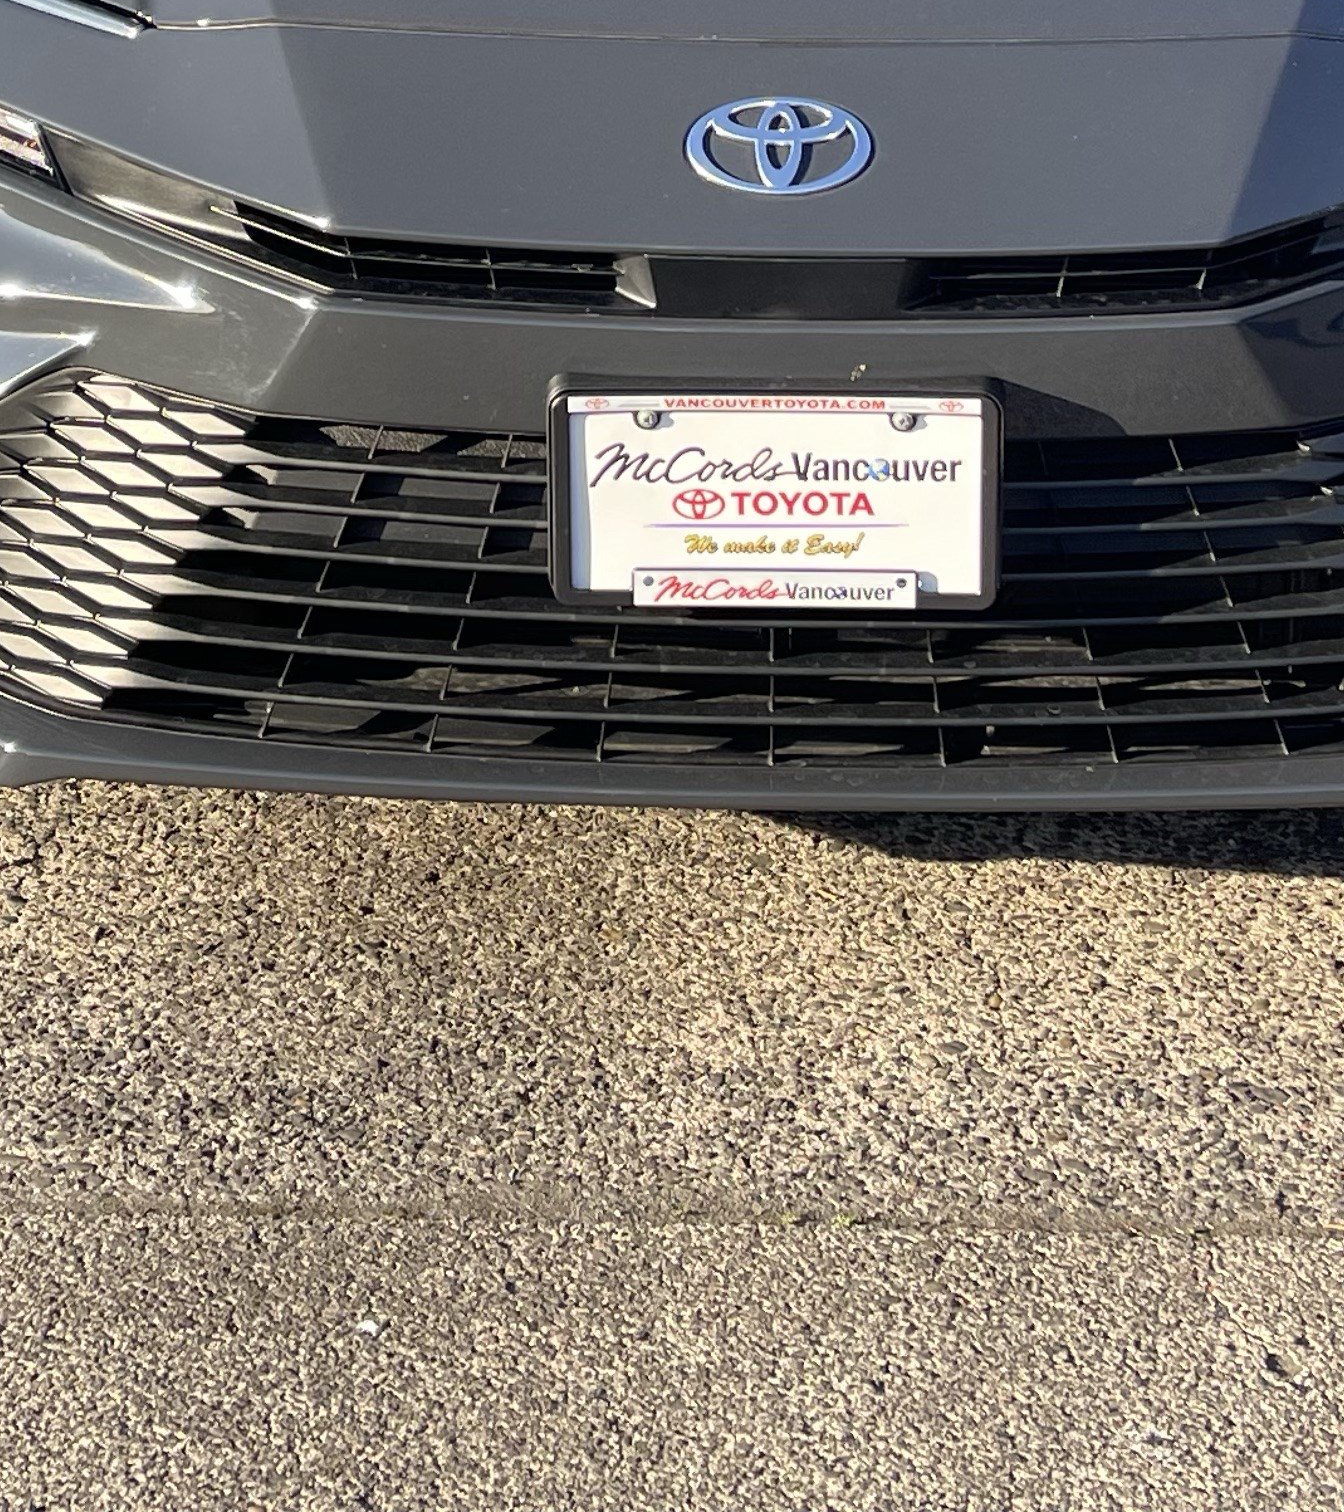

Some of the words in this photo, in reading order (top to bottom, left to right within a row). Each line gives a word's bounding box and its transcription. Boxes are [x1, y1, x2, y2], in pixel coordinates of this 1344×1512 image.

[664, 398, 886, 410] VANCOUVERTOYOTA.COM
[590, 443, 795, 487] McCords
[792, 451, 962, 482] Vancouver
[730, 491, 875, 516] TOYOTA
[684, 534, 718, 554] We
[723, 534, 775, 554] make
[803, 532, 866, 559] Easy!
[654, 575, 791, 601] McCords
[785, 583, 895, 602] Vancouver
